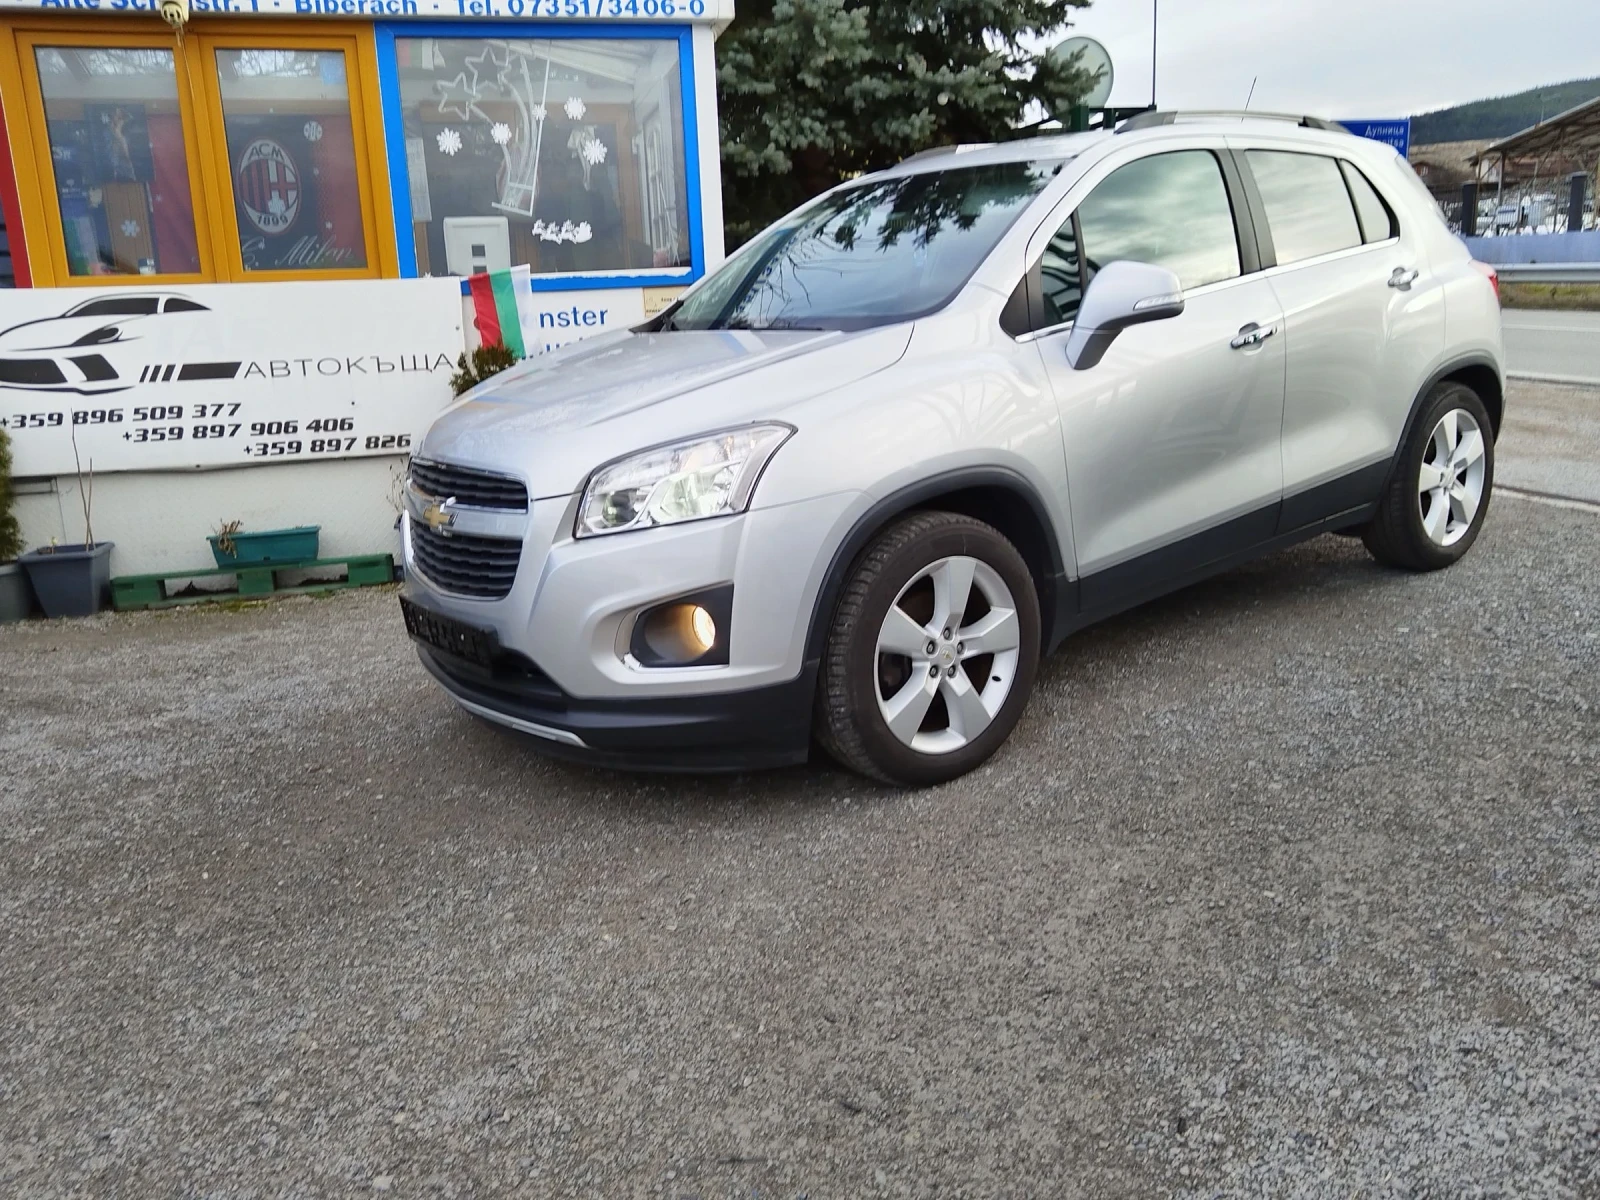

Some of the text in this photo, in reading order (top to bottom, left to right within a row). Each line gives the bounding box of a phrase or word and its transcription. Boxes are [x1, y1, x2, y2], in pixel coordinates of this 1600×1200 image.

[295, 0, 418, 15] Biberach
[456, 0, 500, 15] Tel.
[507, 0, 705, 16] 07351/3406-0
[249, 143, 284, 160] ACM
[539, 306, 608, 328] nster
[244, 353, 454, 379] АВТОКЪЩА
[0, 403, 242, 429] +359 896 509 377
[122, 418, 354, 443] +359 897 906 406
[243, 435, 411, 456] +359 897 826
